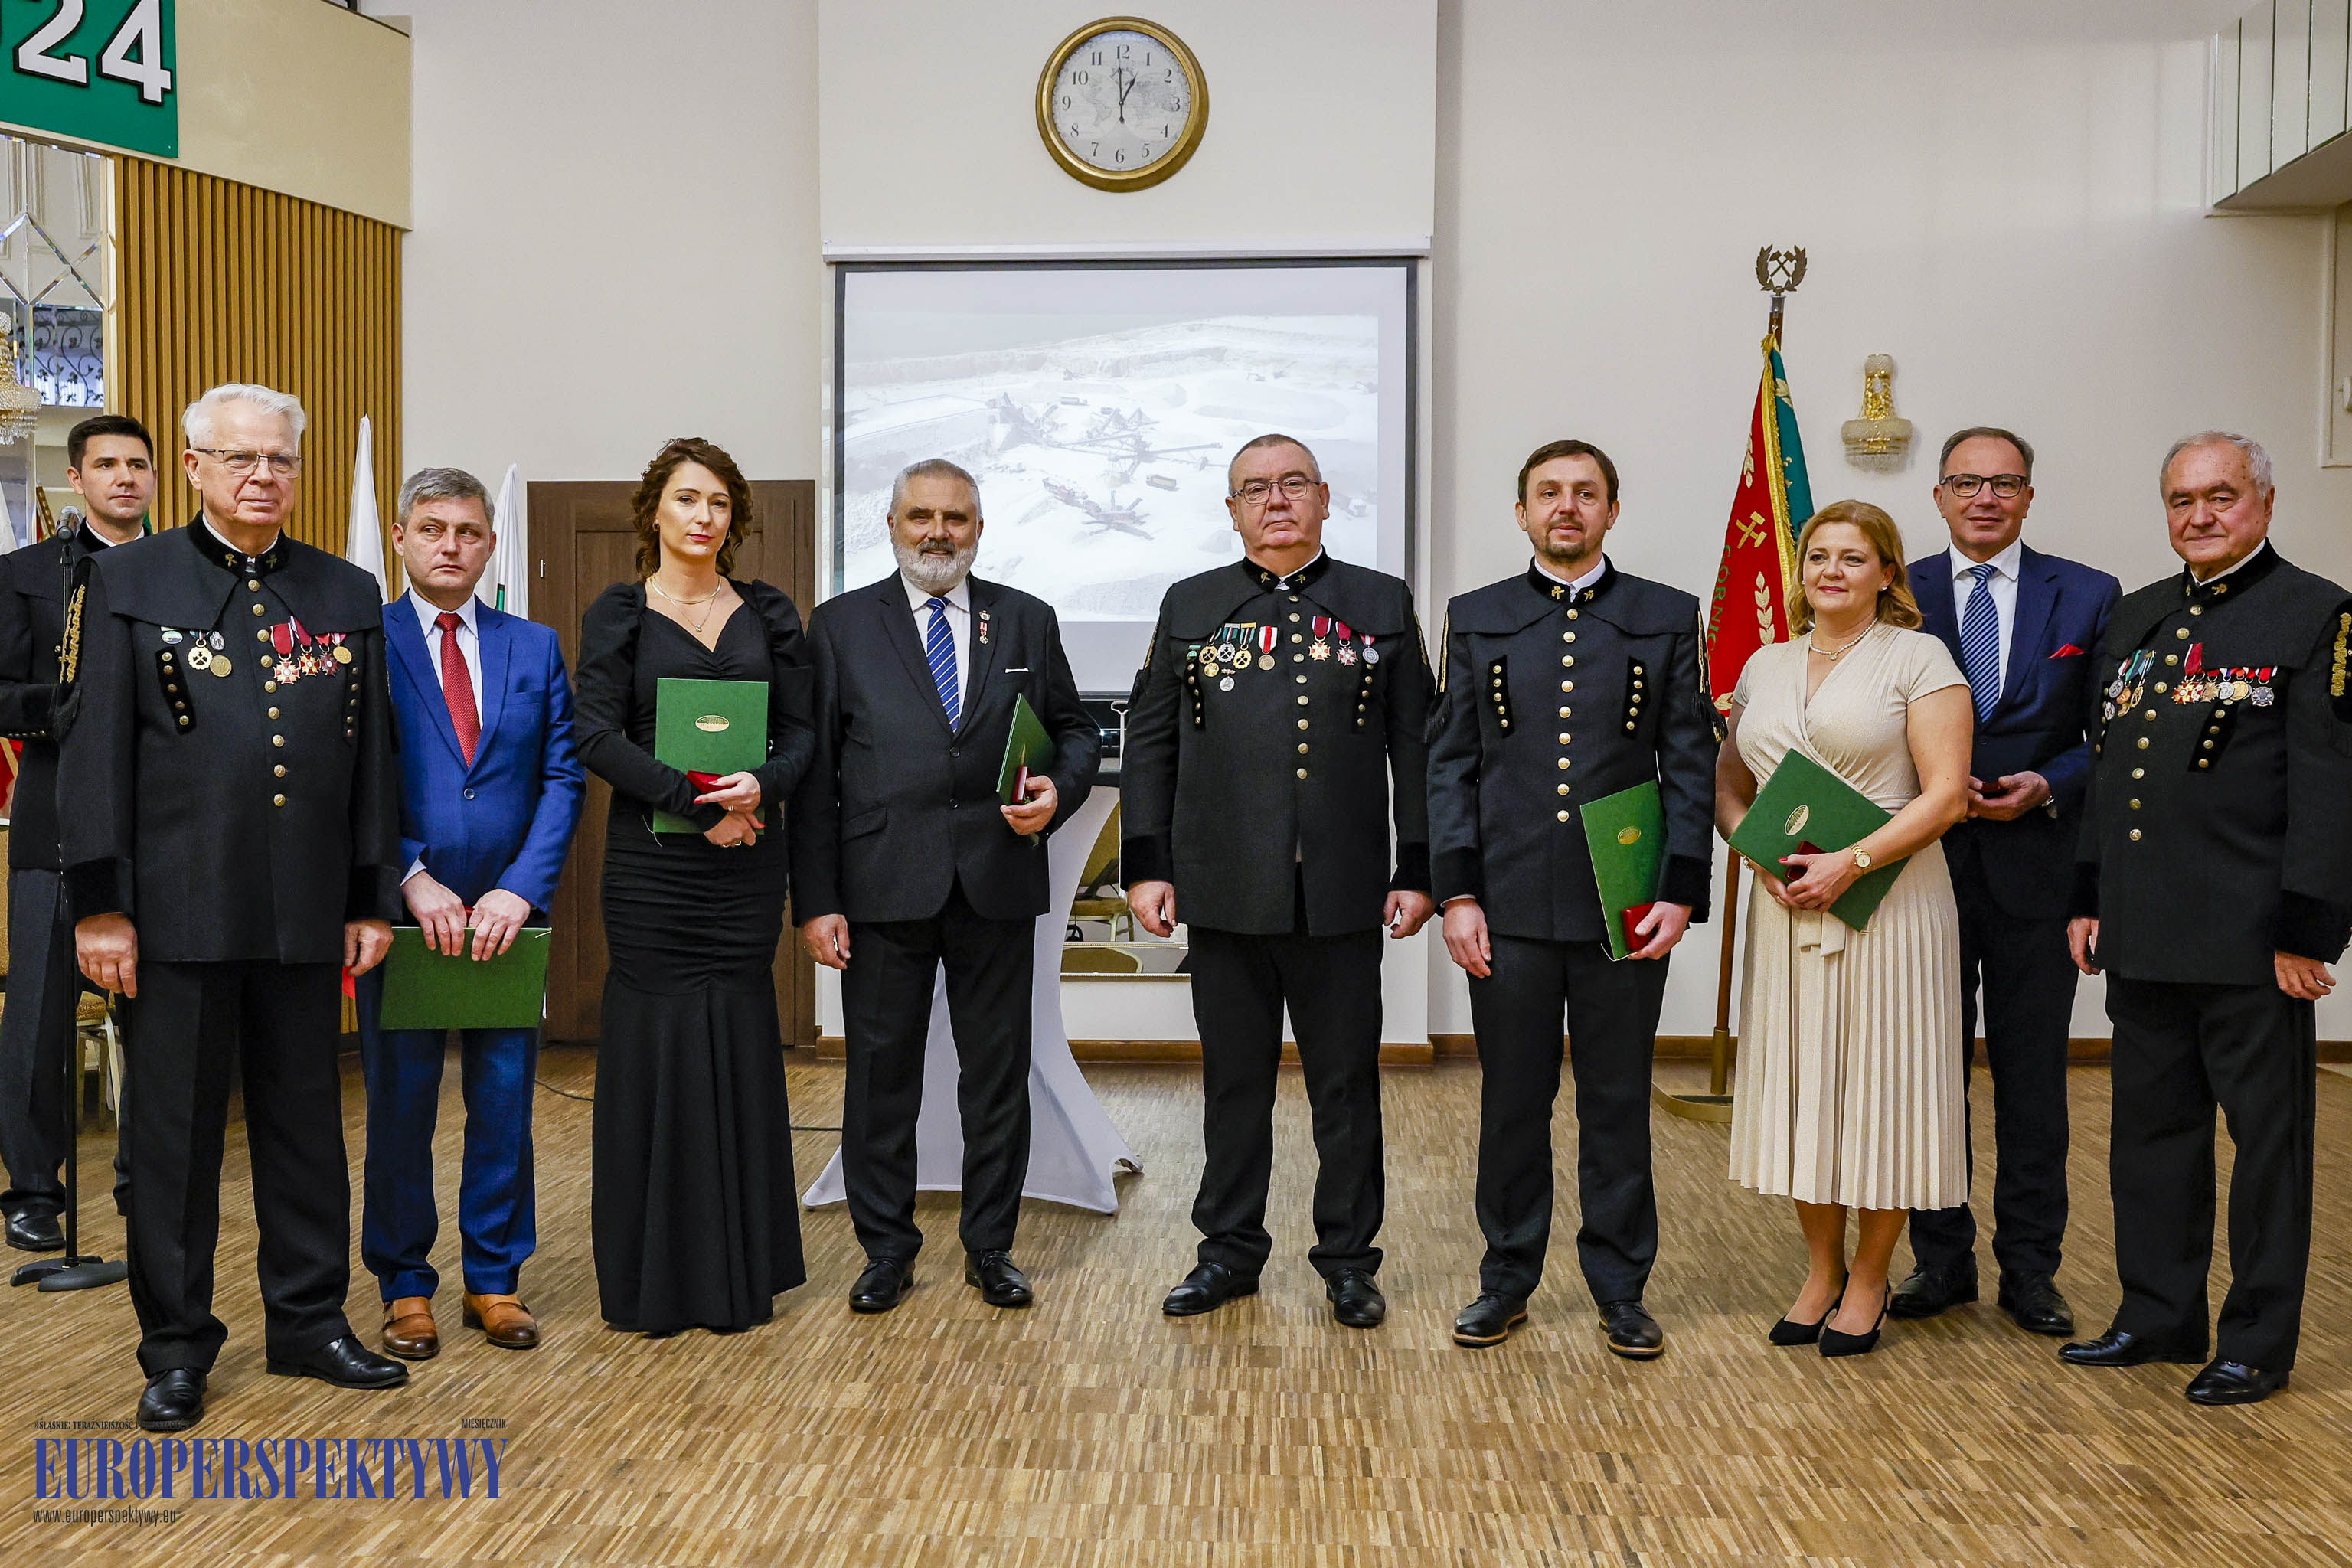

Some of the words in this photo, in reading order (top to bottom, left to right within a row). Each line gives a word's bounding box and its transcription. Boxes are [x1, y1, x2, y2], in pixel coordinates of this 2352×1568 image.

[1091, 51, 1102, 66] 11
[1116, 44, 1130, 59] 12
[1145, 52, 1151, 66] 1
[1072, 70, 1089, 85] 10
[1164, 69, 1172, 83] 2
[1062, 95, 1071, 111] 9
[1171, 96, 1181, 112] 3
[1070, 123, 1079, 137] 8
[1091, 142, 1099, 156] 7
[1115, 149, 1125, 163] 6
[1141, 143, 1150, 158] 5
